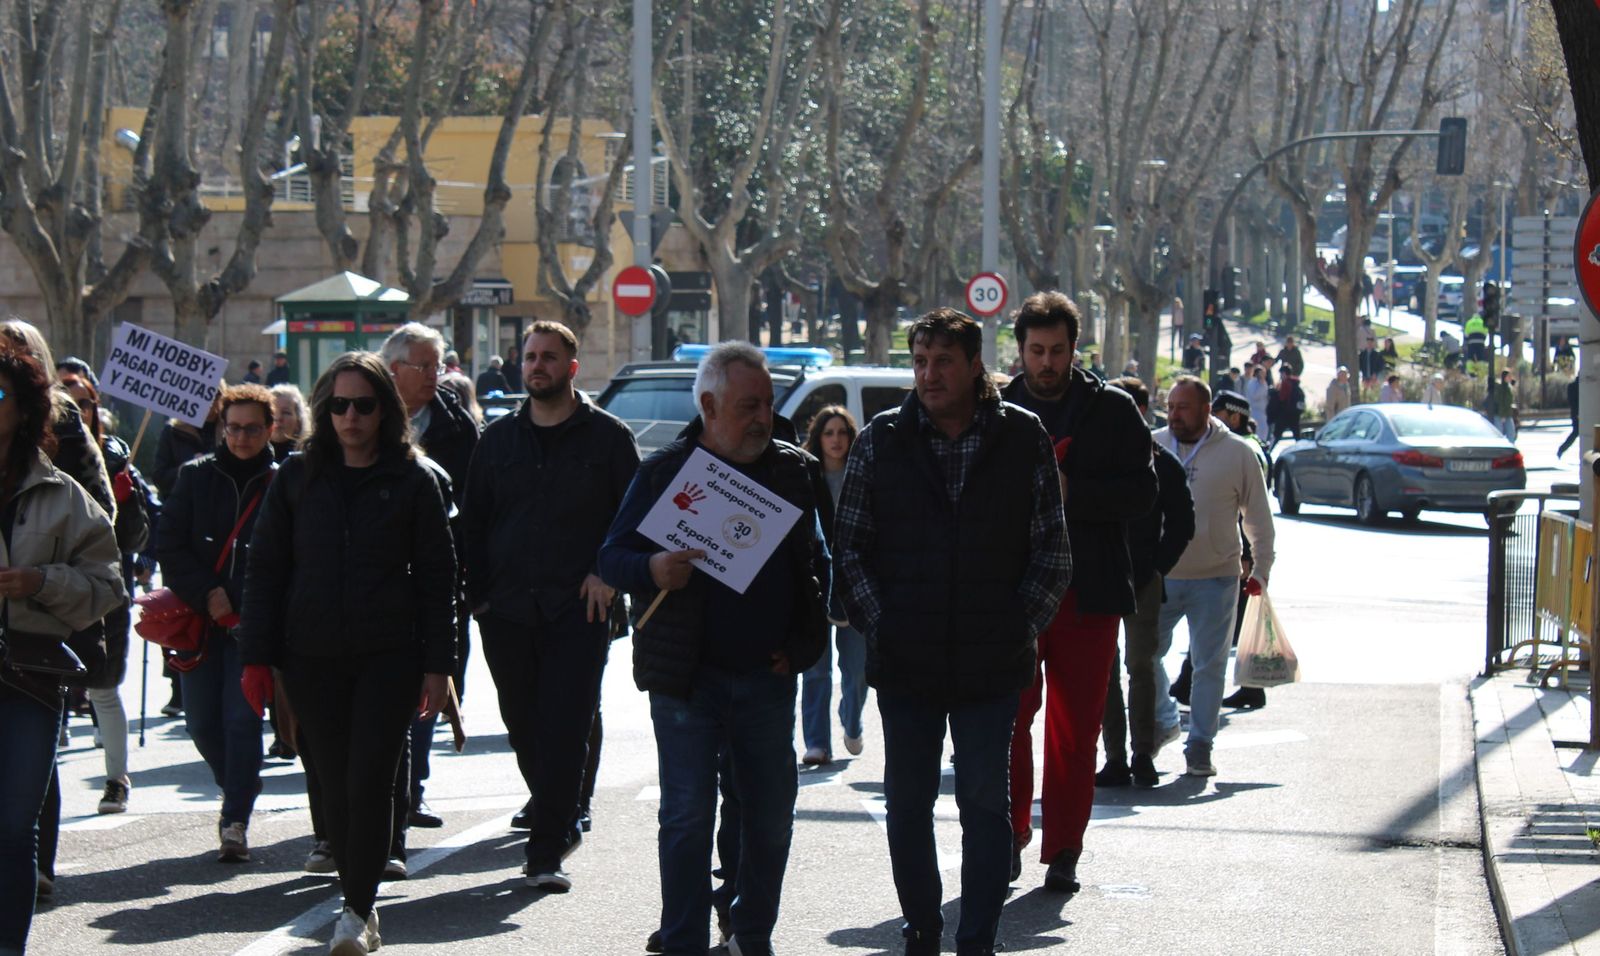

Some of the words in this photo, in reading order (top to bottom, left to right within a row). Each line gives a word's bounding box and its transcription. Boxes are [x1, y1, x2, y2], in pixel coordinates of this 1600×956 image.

[975, 287, 998, 301] 30
[110, 347, 159, 378] PAGAR
[159, 368, 216, 401] CUOTAS
[126, 328, 151, 352] MI
[151, 339, 216, 379] HOBBY:
[110, 369, 122, 385] Y
[121, 375, 200, 418] FACTURAS
[706, 462, 719, 474] Si
[718, 473, 730, 481] el
[729, 479, 783, 513] autónomo
[706, 480, 766, 520] desaparece
[676, 519, 720, 551] España
[720, 549, 735, 560] se
[733, 532, 742, 540] N
[734, 521, 752, 536] 30
